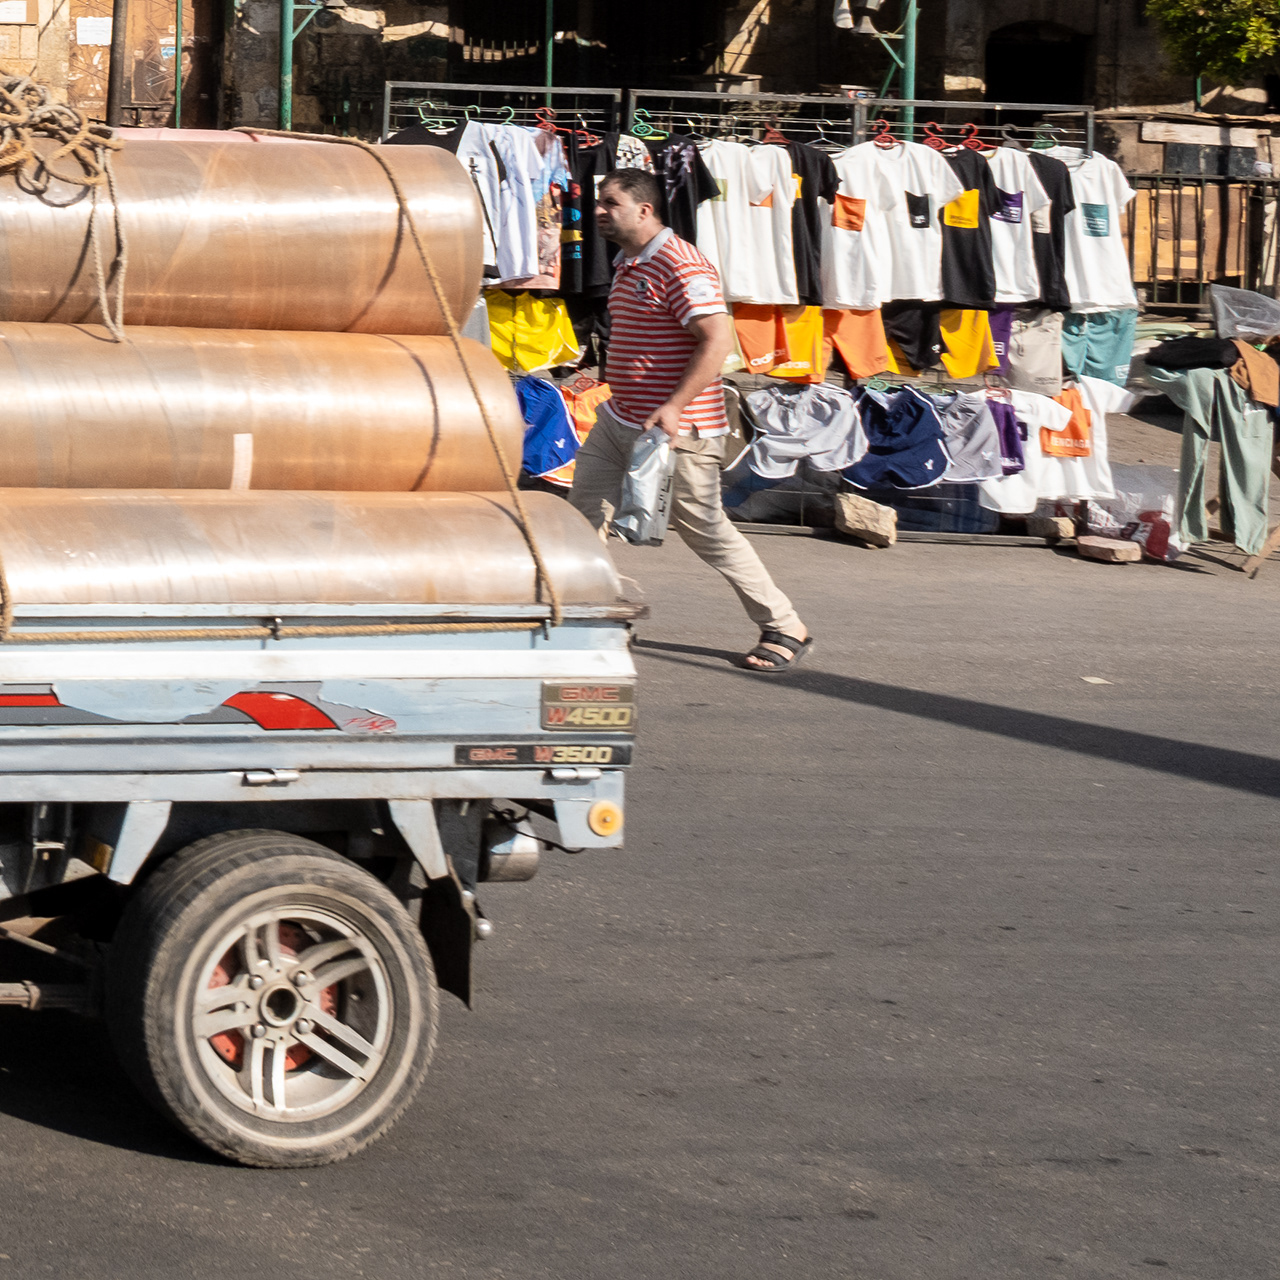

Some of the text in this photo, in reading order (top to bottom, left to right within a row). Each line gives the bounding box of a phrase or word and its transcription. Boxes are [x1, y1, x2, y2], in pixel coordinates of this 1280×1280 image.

[559, 686, 620, 702] GMC
[546, 707, 631, 726] W4500
[468, 746, 614, 763] GMC W3500
